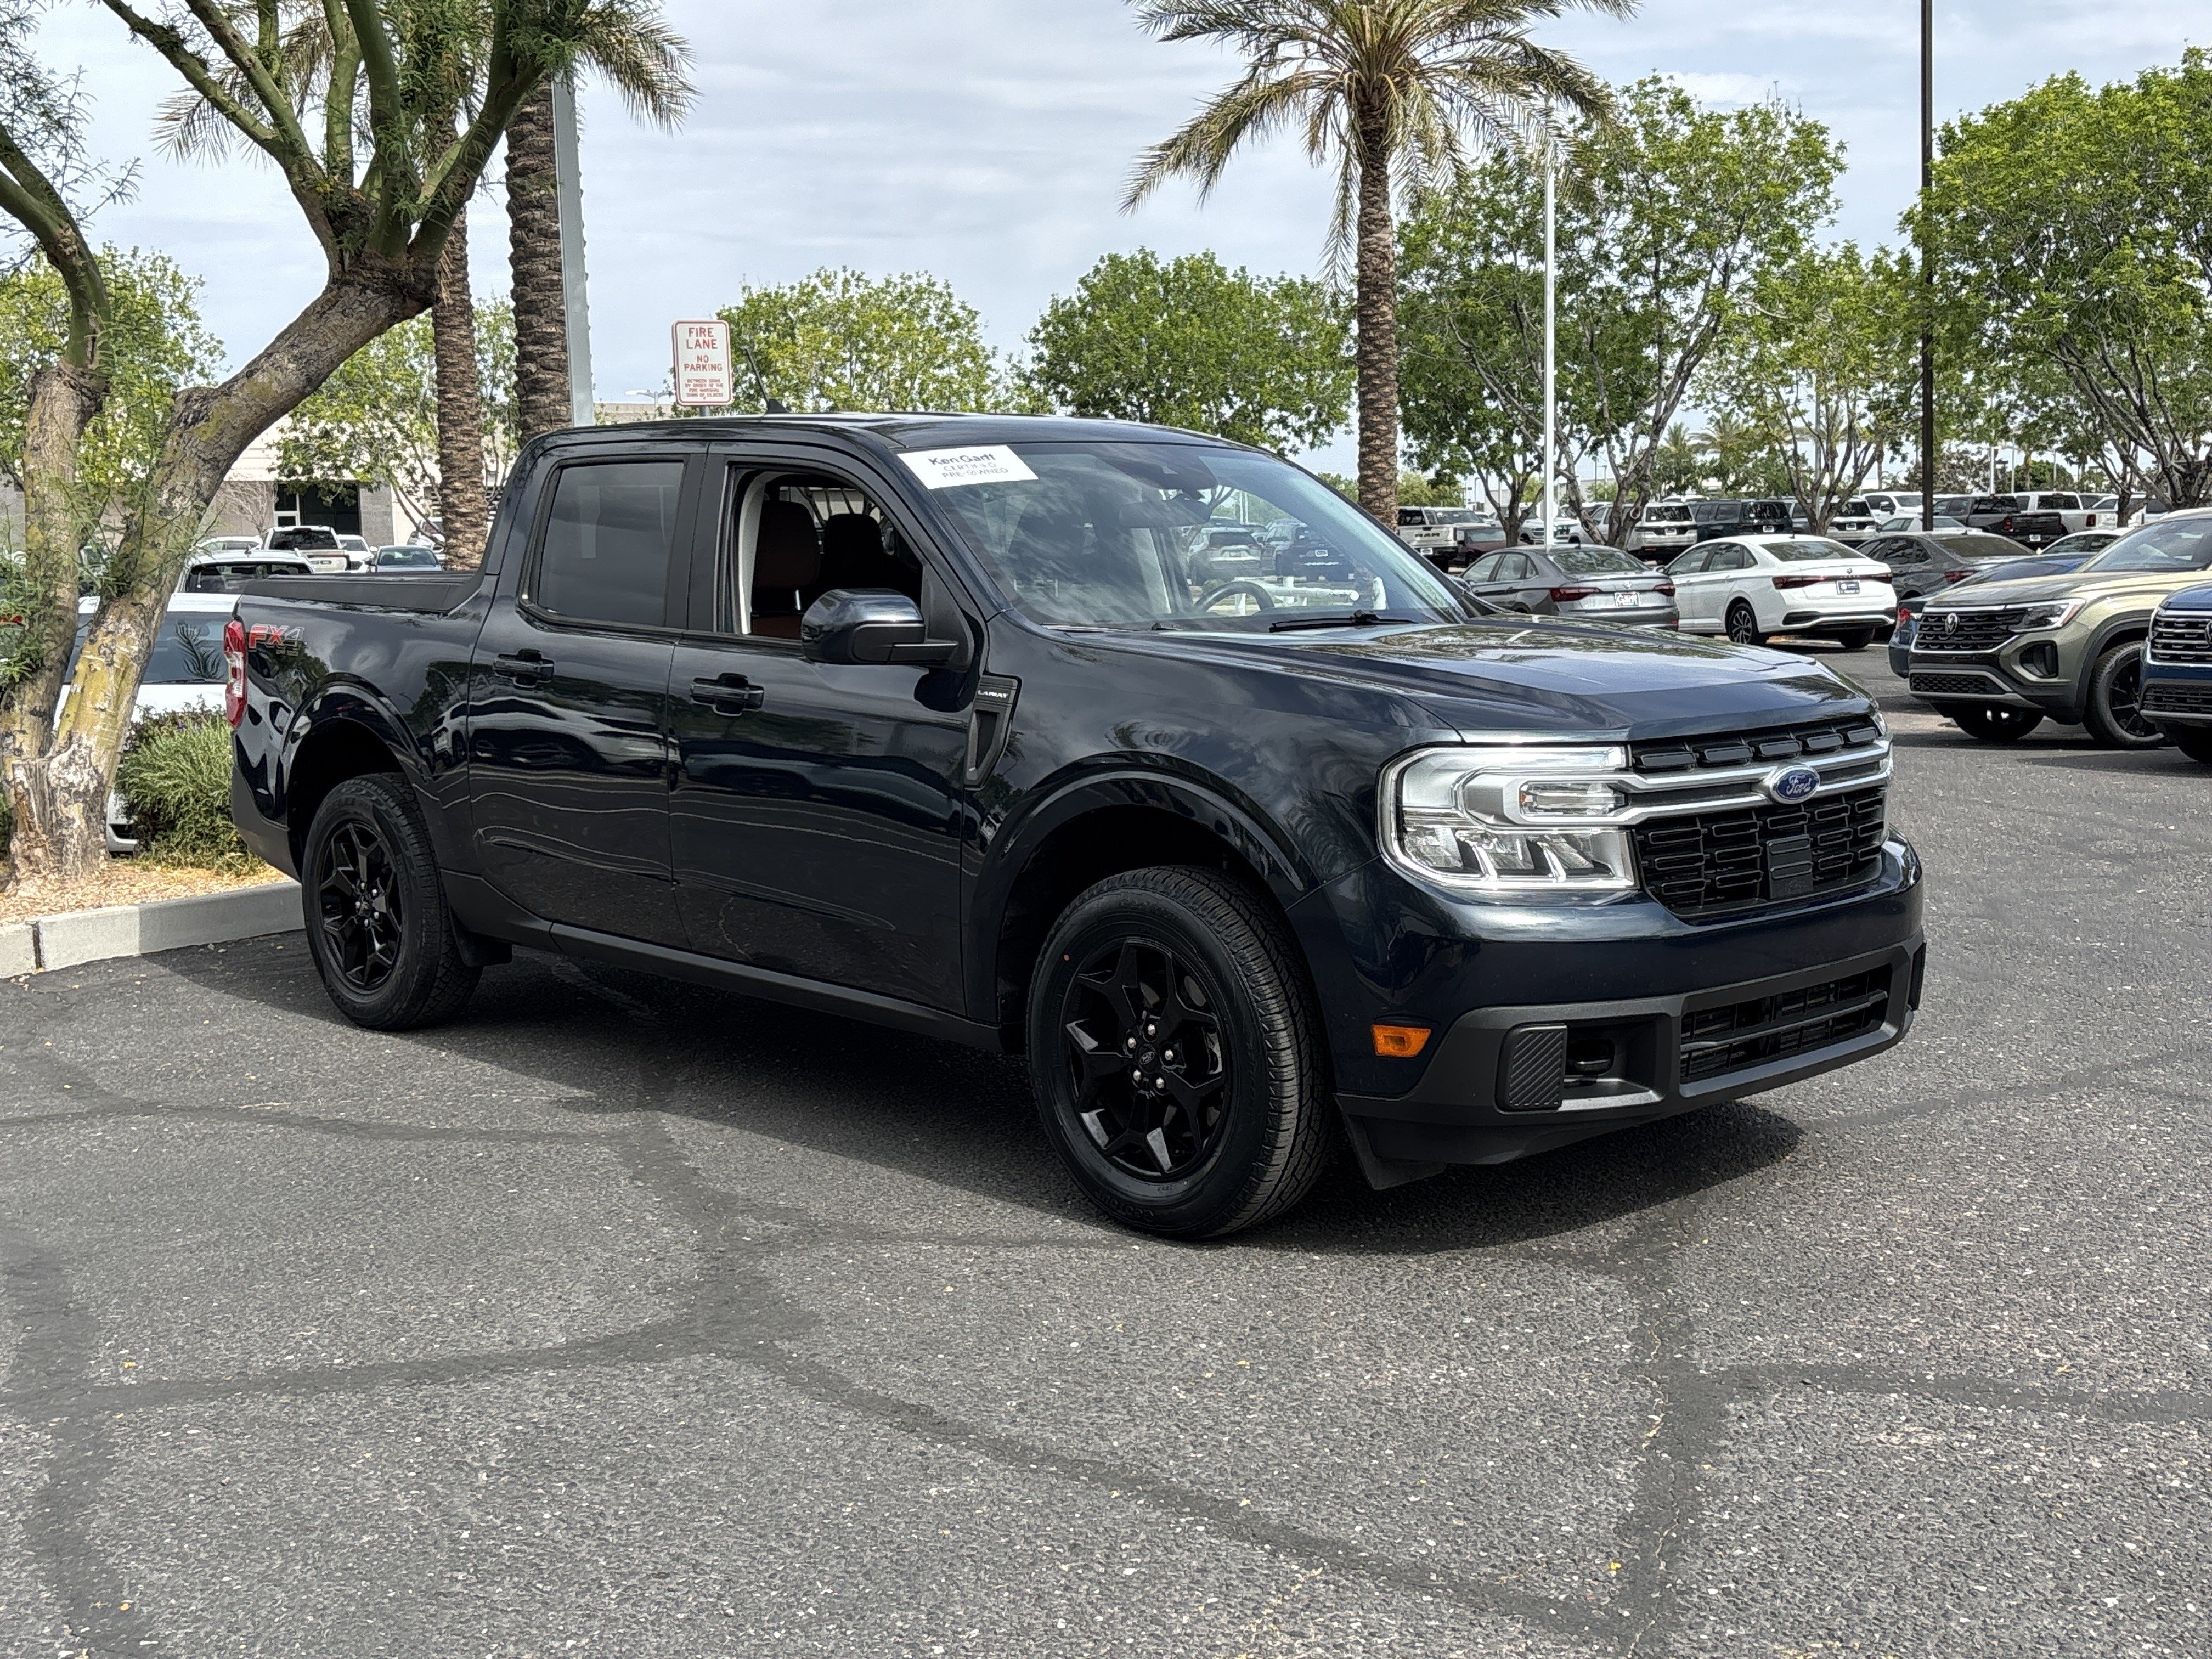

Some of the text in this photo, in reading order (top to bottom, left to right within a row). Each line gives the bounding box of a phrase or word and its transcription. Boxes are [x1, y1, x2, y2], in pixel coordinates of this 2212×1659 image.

[689, 327, 714, 337] FIRE
[686, 338, 718, 349] LANE
[684, 363, 723, 371] PARKING
[248, 623, 305, 652] FX4
[1786, 774, 1812, 795] Ford
